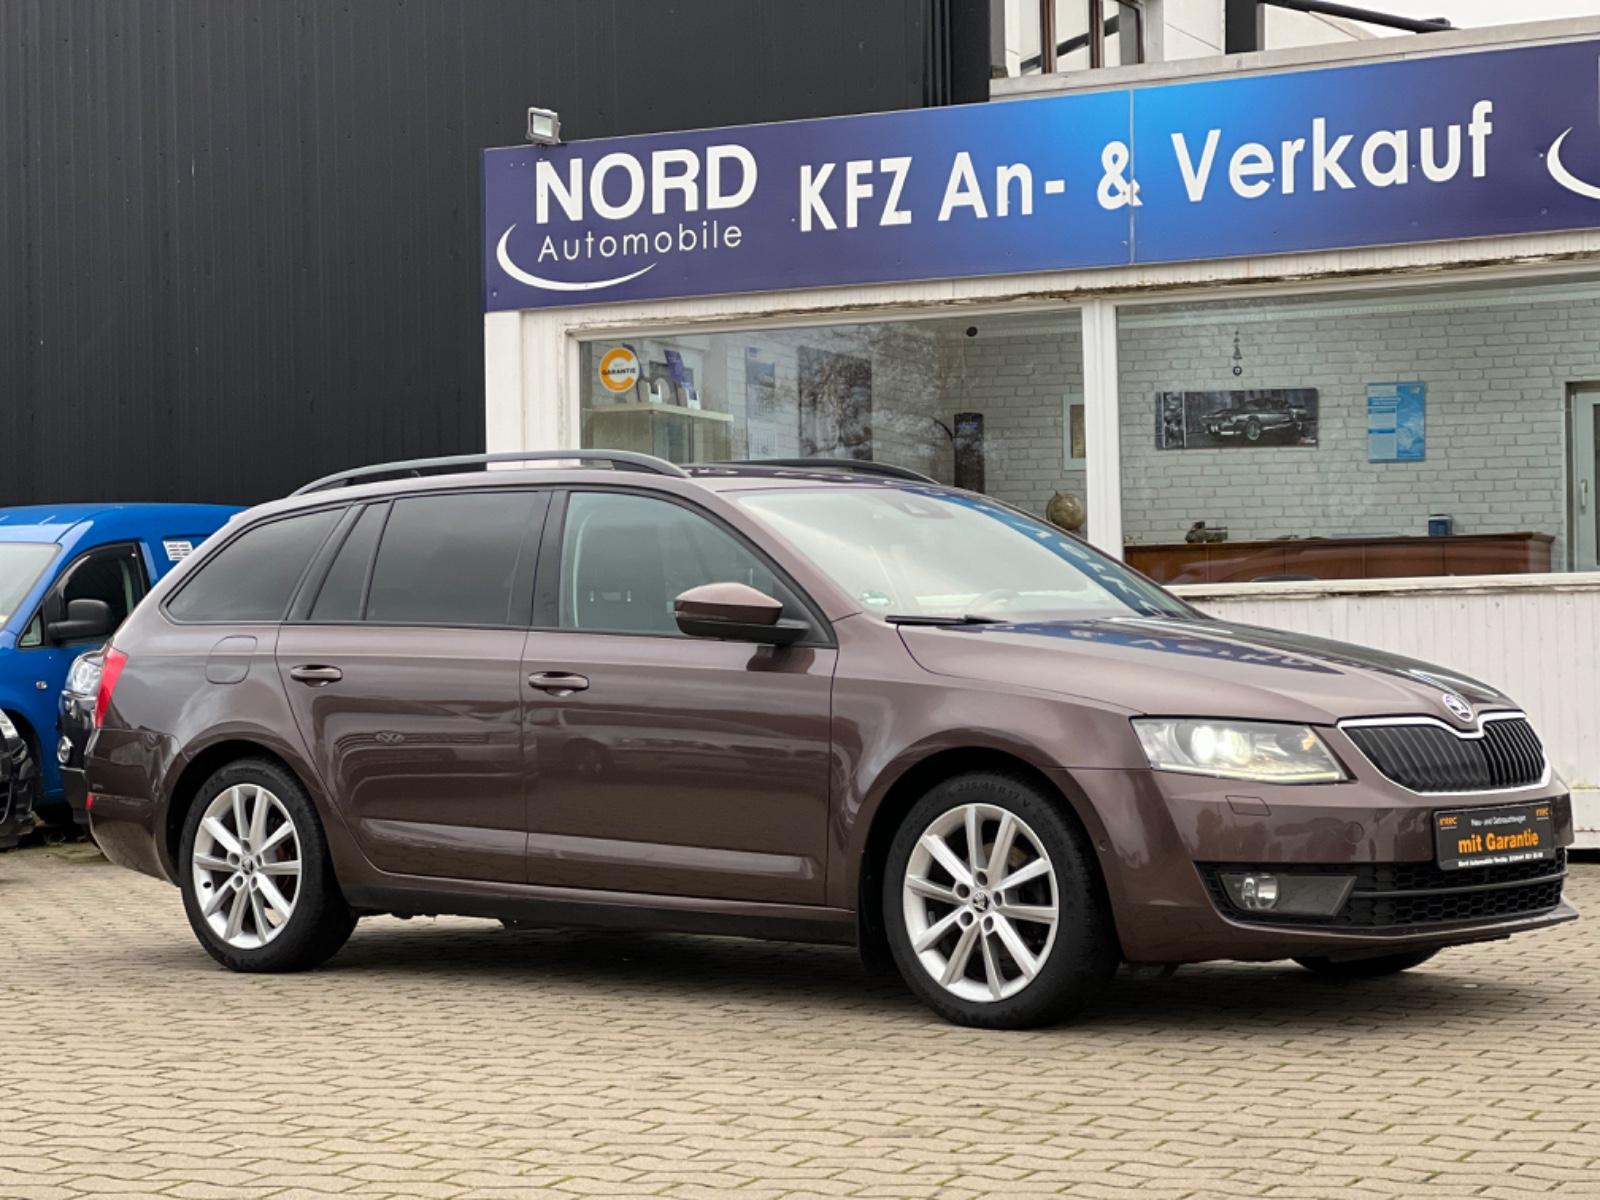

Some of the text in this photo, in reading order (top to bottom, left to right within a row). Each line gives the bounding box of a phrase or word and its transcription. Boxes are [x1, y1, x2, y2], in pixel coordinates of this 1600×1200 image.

[535, 143, 758, 225] NORD
[799, 100, 1493, 233] KFZ An- & Verkauf
[537, 219, 743, 263] Automobile
[1458, 828, 1539, 854] mit Garantie
